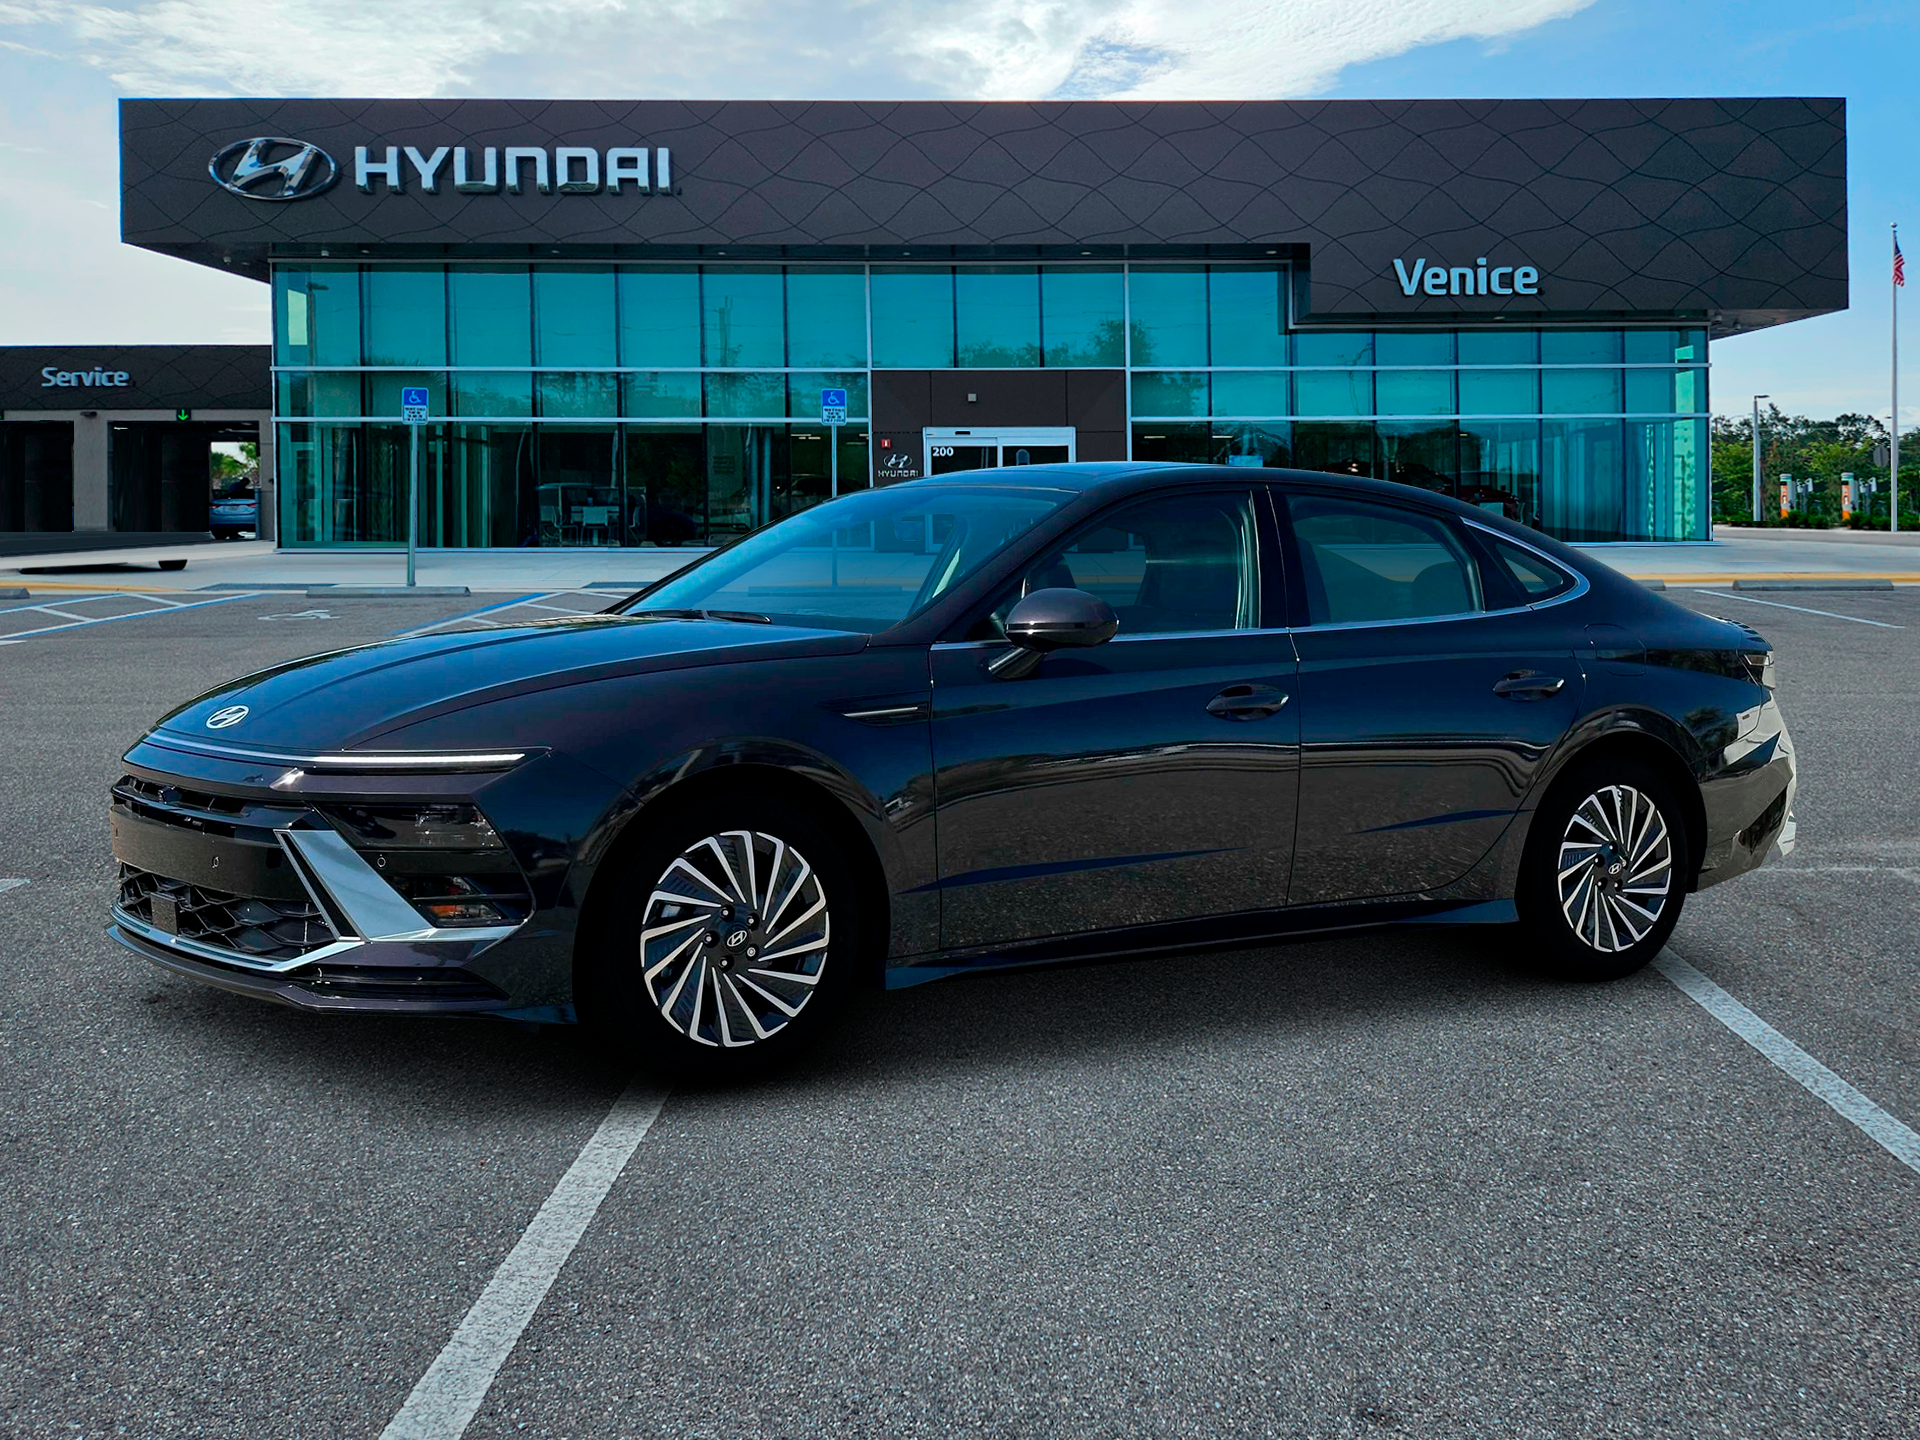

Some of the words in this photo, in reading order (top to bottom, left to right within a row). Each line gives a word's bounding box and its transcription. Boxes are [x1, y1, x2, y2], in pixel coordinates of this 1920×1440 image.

[354, 146, 673, 194] HYUNDAI
[1392, 257, 1539, 296] Venice
[41, 366, 130, 387] Service
[932, 446, 954, 457] 200
[877, 469, 919, 478] HYUNDAI
